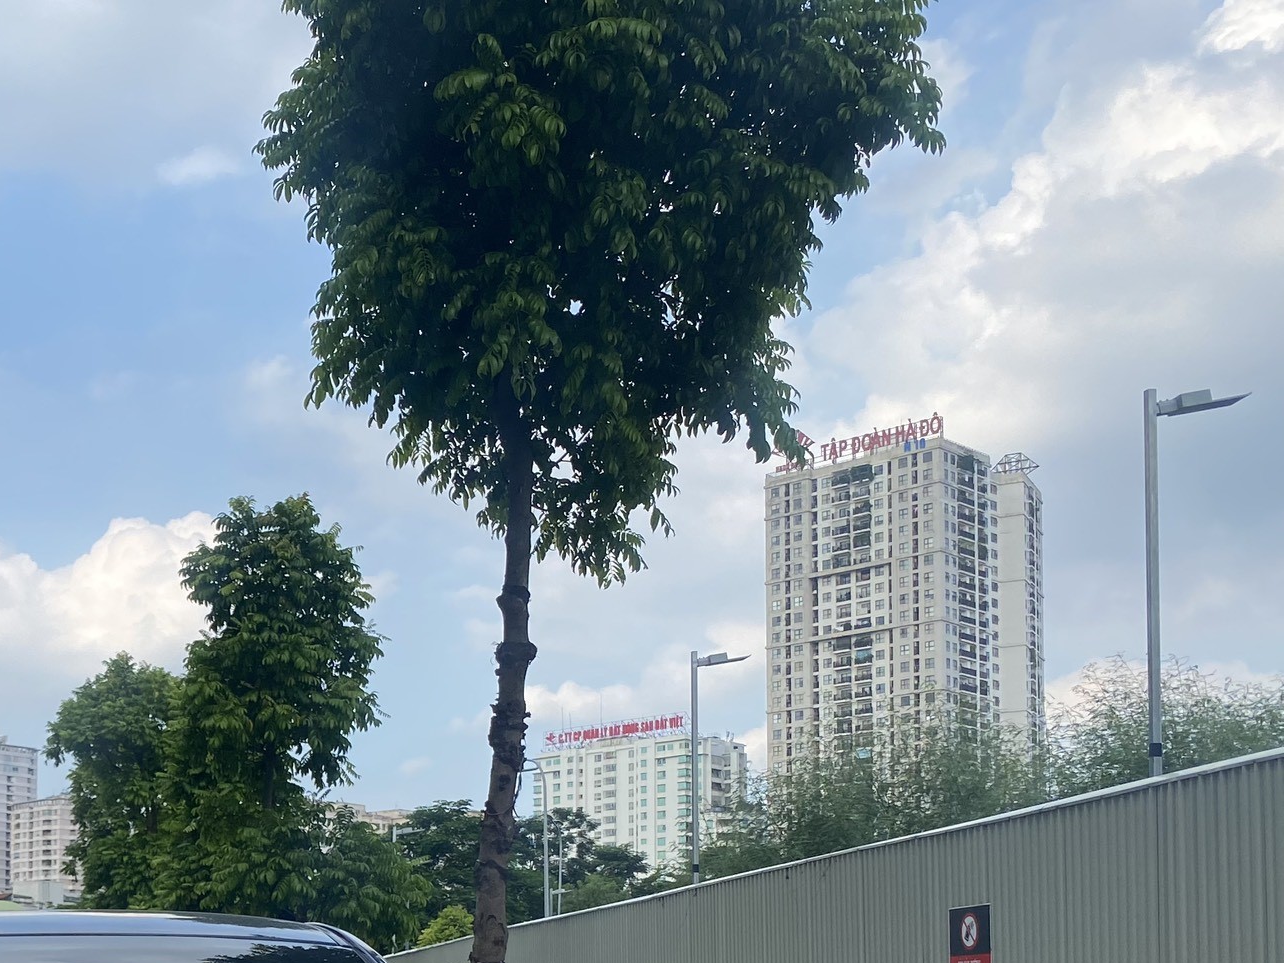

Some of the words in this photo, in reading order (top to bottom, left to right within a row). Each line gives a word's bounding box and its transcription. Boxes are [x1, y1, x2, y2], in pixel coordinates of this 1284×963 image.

[821, 437, 847, 464] TẬP
[851, 427, 891, 454] ĐOÀN
[896, 418, 917, 443] HÀ
